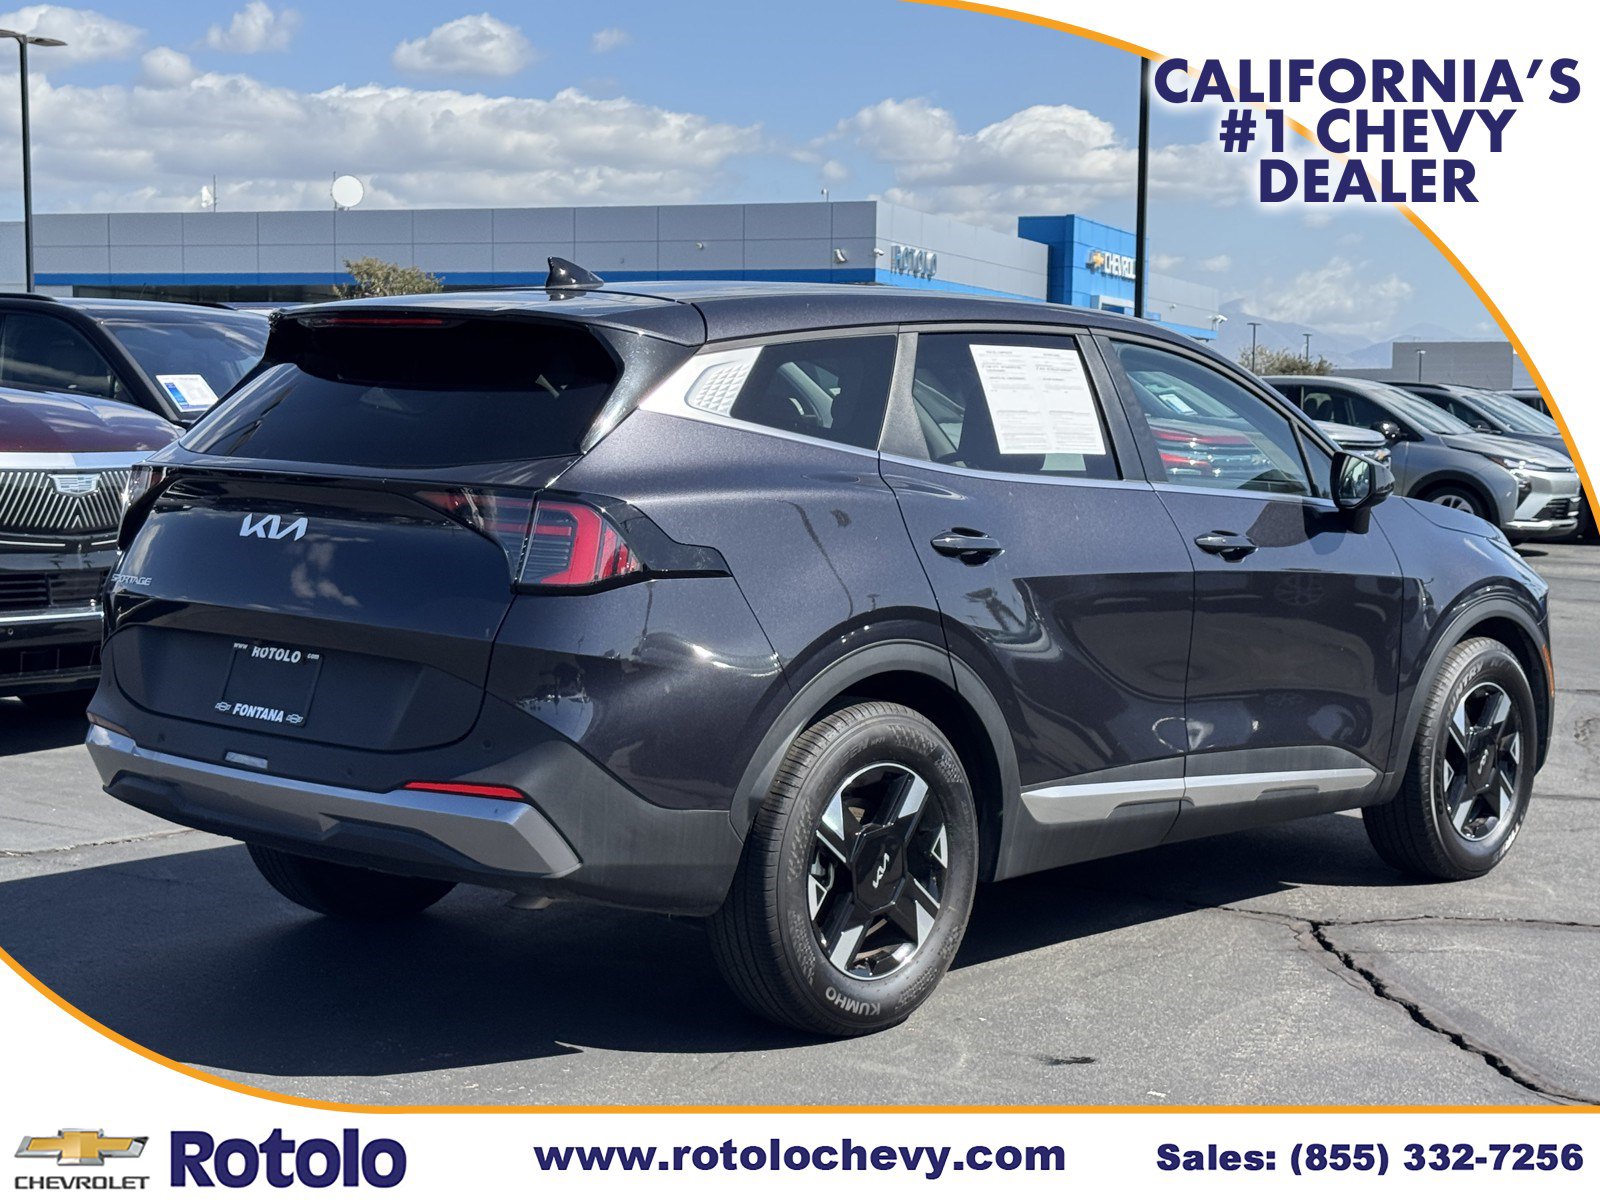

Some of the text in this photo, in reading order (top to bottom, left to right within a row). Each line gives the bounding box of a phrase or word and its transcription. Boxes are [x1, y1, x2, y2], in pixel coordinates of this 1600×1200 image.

[239, 513, 309, 541] KIA
[251, 646, 302, 663] ROTOLO
[232, 703, 285, 722] FONTANA
[825, 985, 881, 1017] KUMHO
